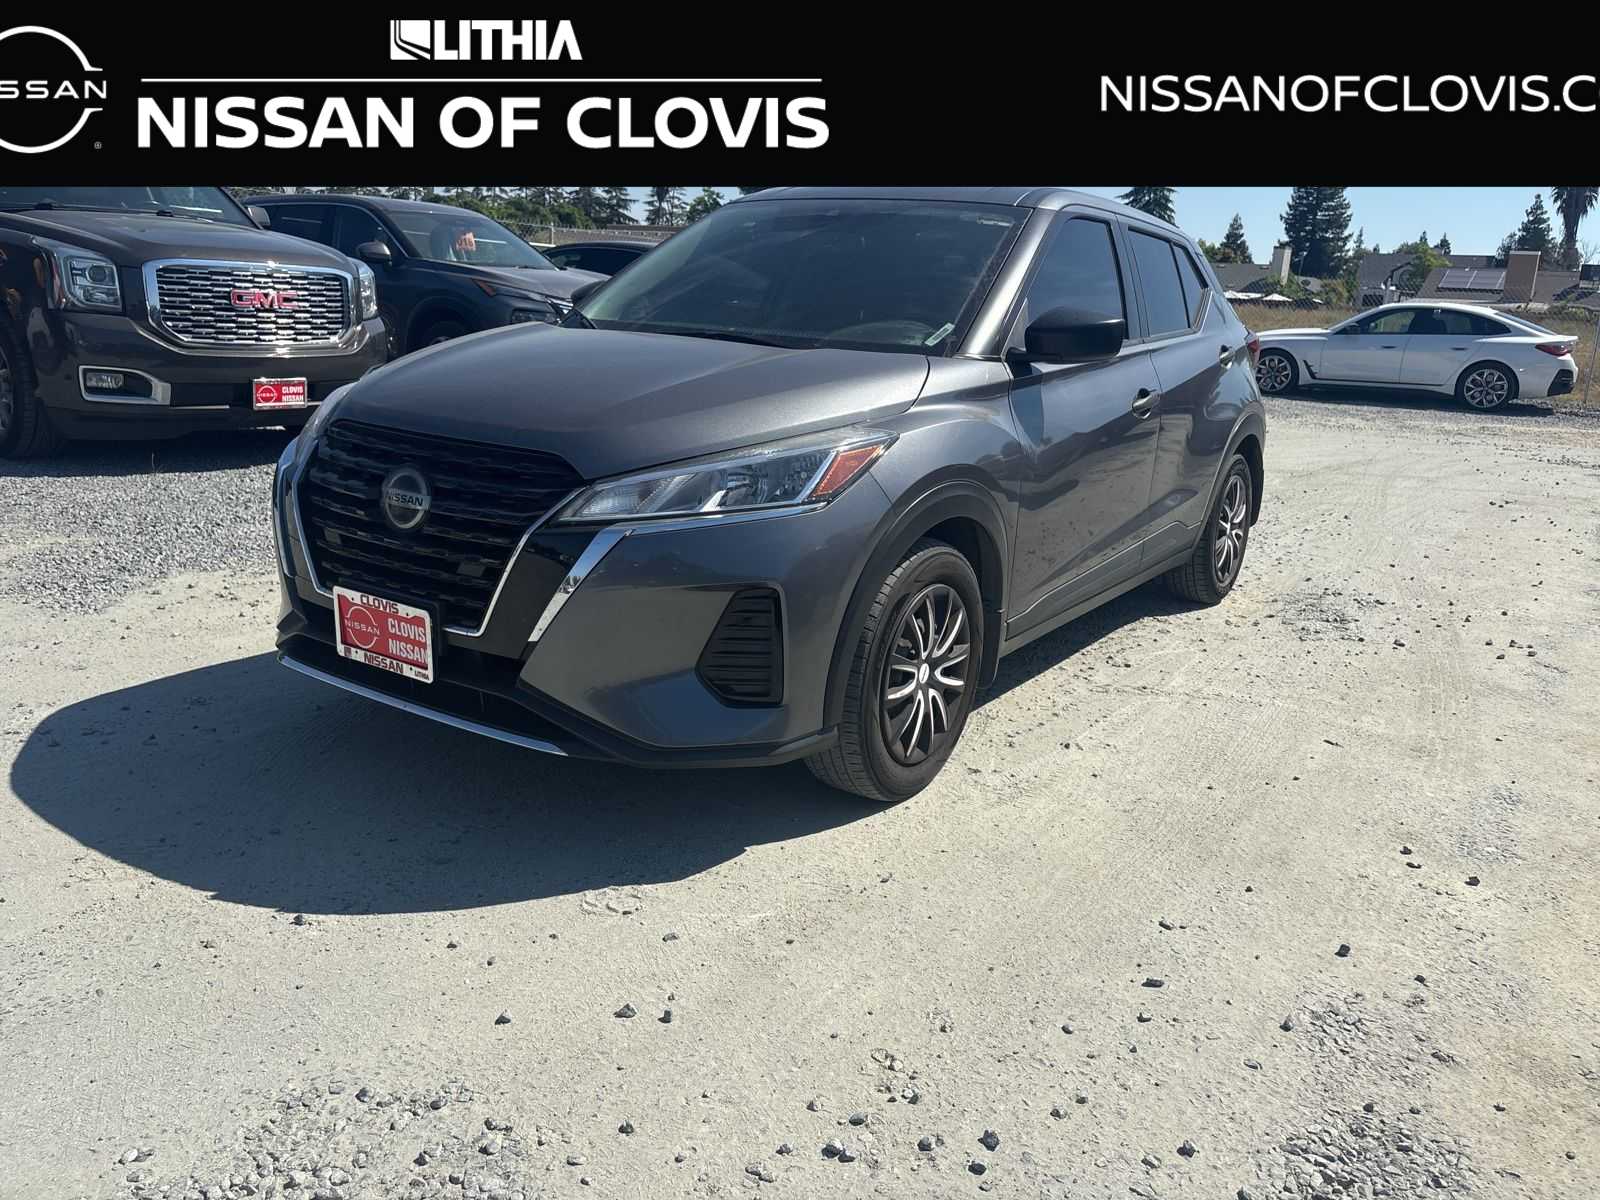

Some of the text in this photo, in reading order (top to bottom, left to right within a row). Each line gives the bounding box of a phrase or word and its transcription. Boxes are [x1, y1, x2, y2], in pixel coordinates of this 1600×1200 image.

[231, 288, 298, 310] GMC
[282, 386, 304, 394] CLOVIS
[282, 394, 304, 402] NISSAN
[360, 594, 400, 614] CLOVIS
[345, 619, 380, 636] NISSAN
[387, 618, 426, 643] CLOVIS
[388, 638, 428, 664] NISSAN
[363, 652, 404, 674] NISSAN
